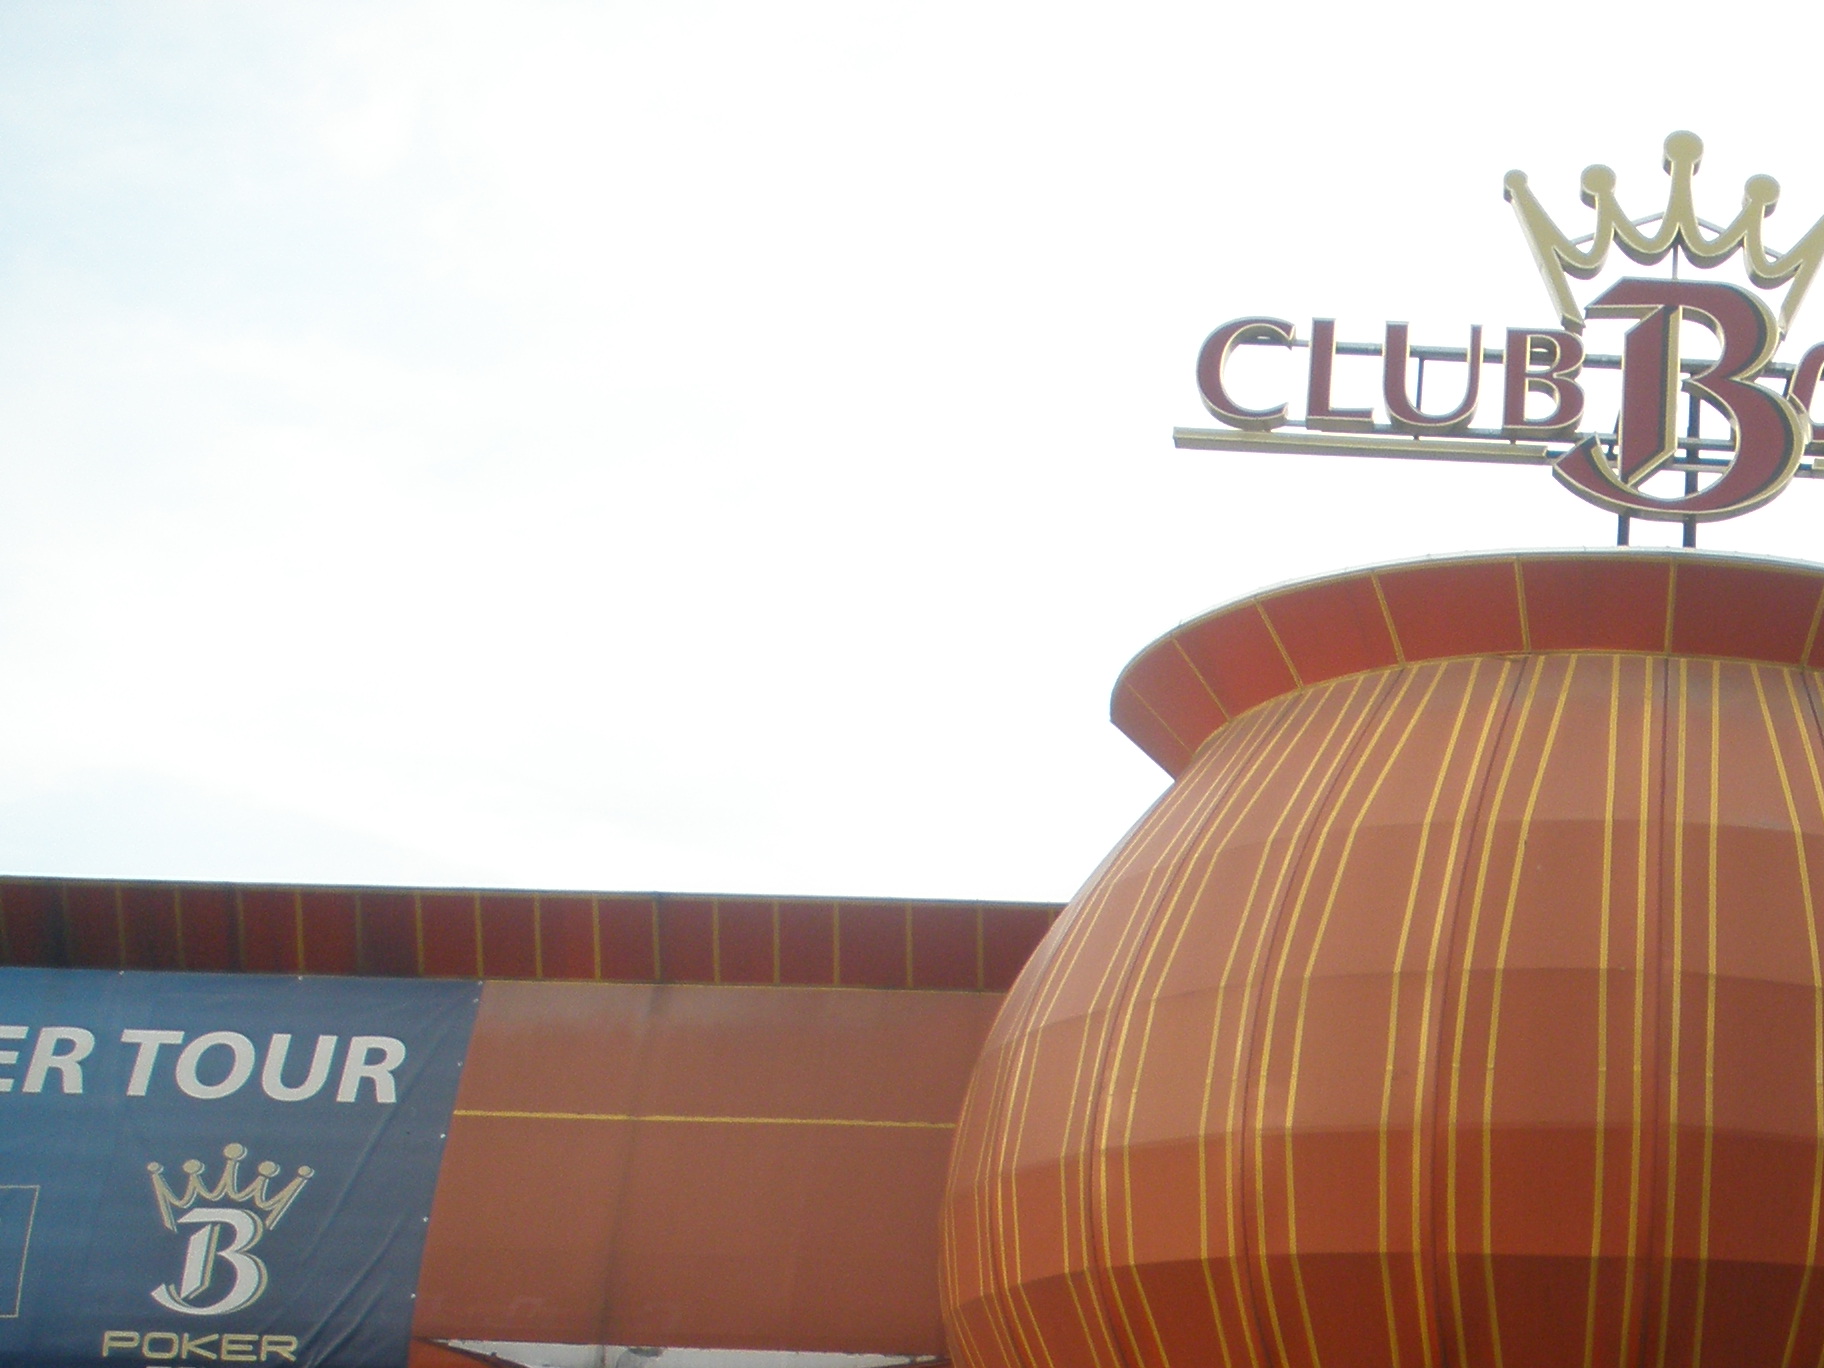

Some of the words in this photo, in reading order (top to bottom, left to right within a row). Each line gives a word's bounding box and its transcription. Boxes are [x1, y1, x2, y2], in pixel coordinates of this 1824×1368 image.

[1195, 316, 1586, 438] CLUB
[121, 1029, 407, 1103] TOUR
[101, 1331, 298, 1363] POKER
